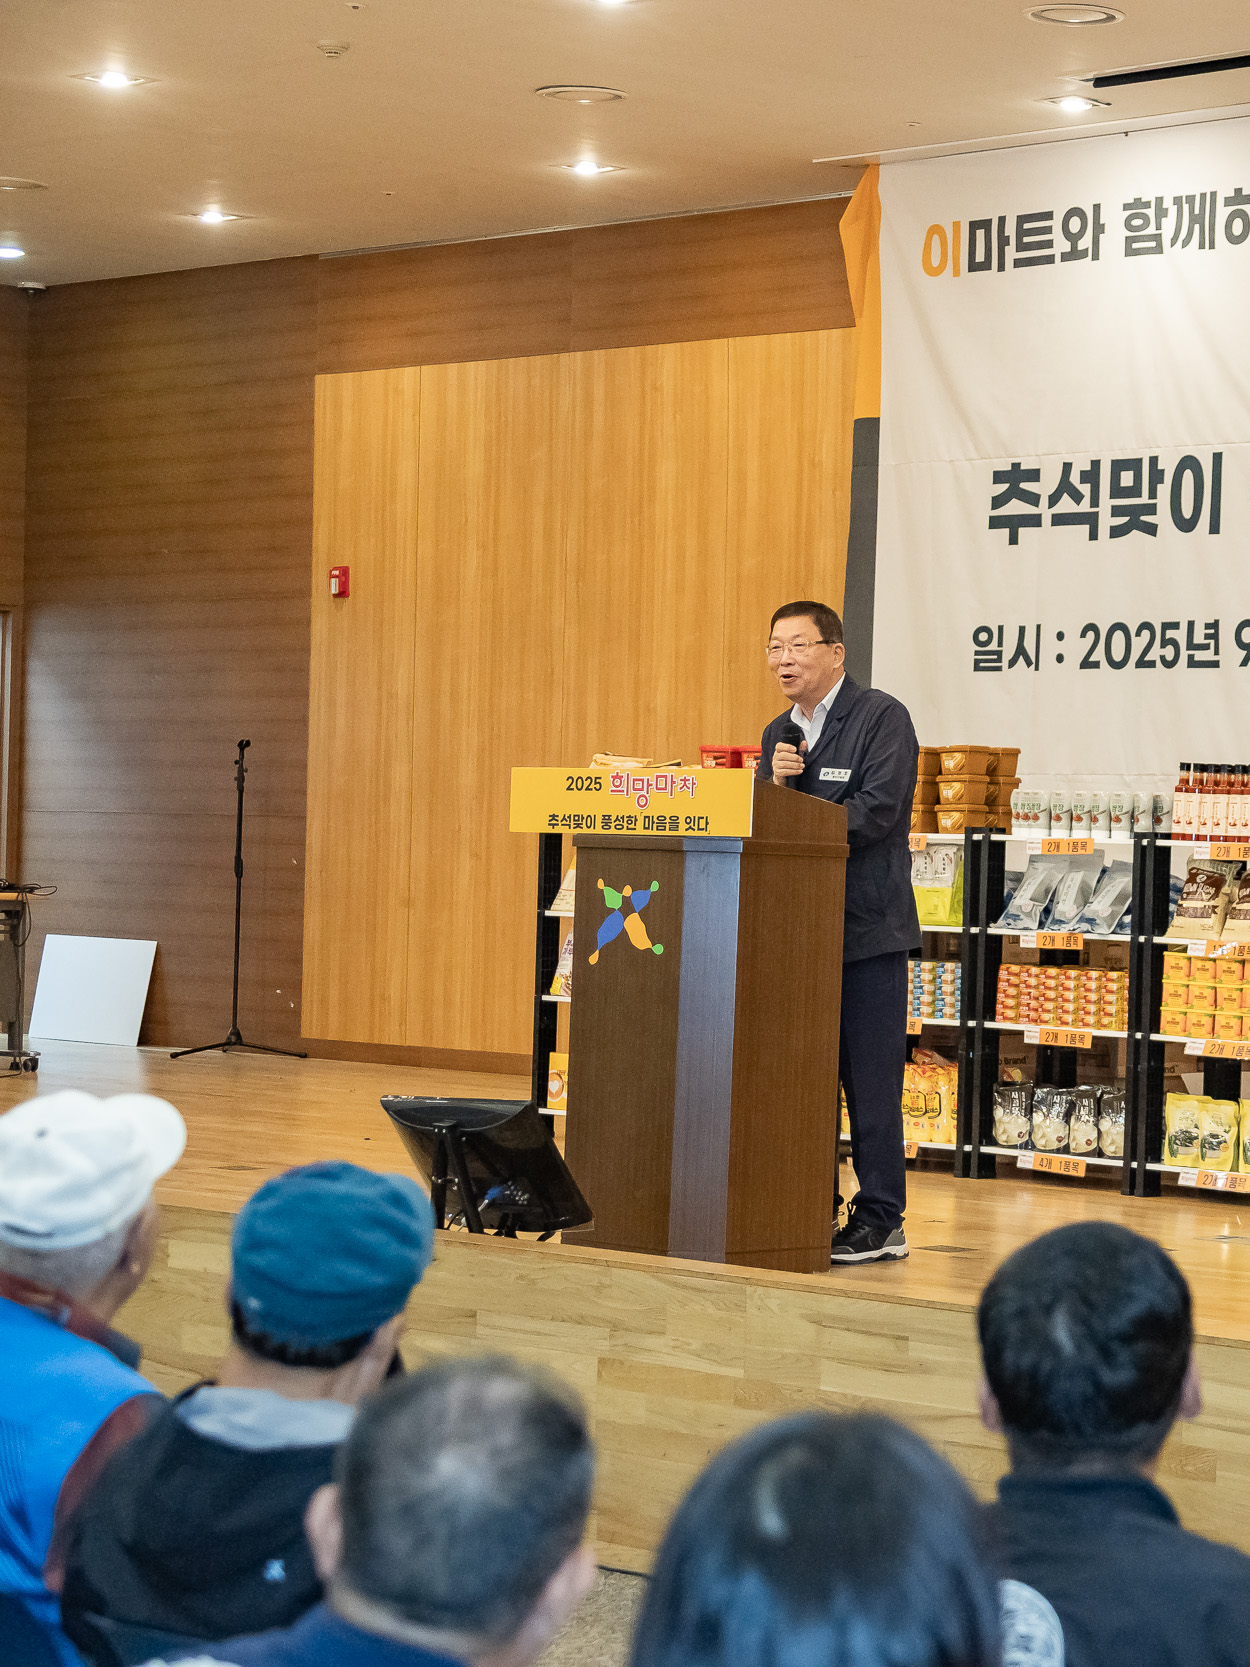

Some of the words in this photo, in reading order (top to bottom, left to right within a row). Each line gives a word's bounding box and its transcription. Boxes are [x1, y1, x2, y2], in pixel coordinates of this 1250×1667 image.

[921, 204, 1105, 278] 이마트와
[987, 451, 1221, 546] 추석맞이
[971, 623, 1042, 672] 일시
[1079, 617, 1221, 670] 2025년
[566, 776, 602, 791] 2025
[609, 771, 698, 810] 희망마차
[548, 813, 596, 830] 추석맞이
[600, 814, 638, 831] 풍성한
[1067, 841, 1088, 852] 1품목
[1065, 1034, 1085, 1045] 1품목
